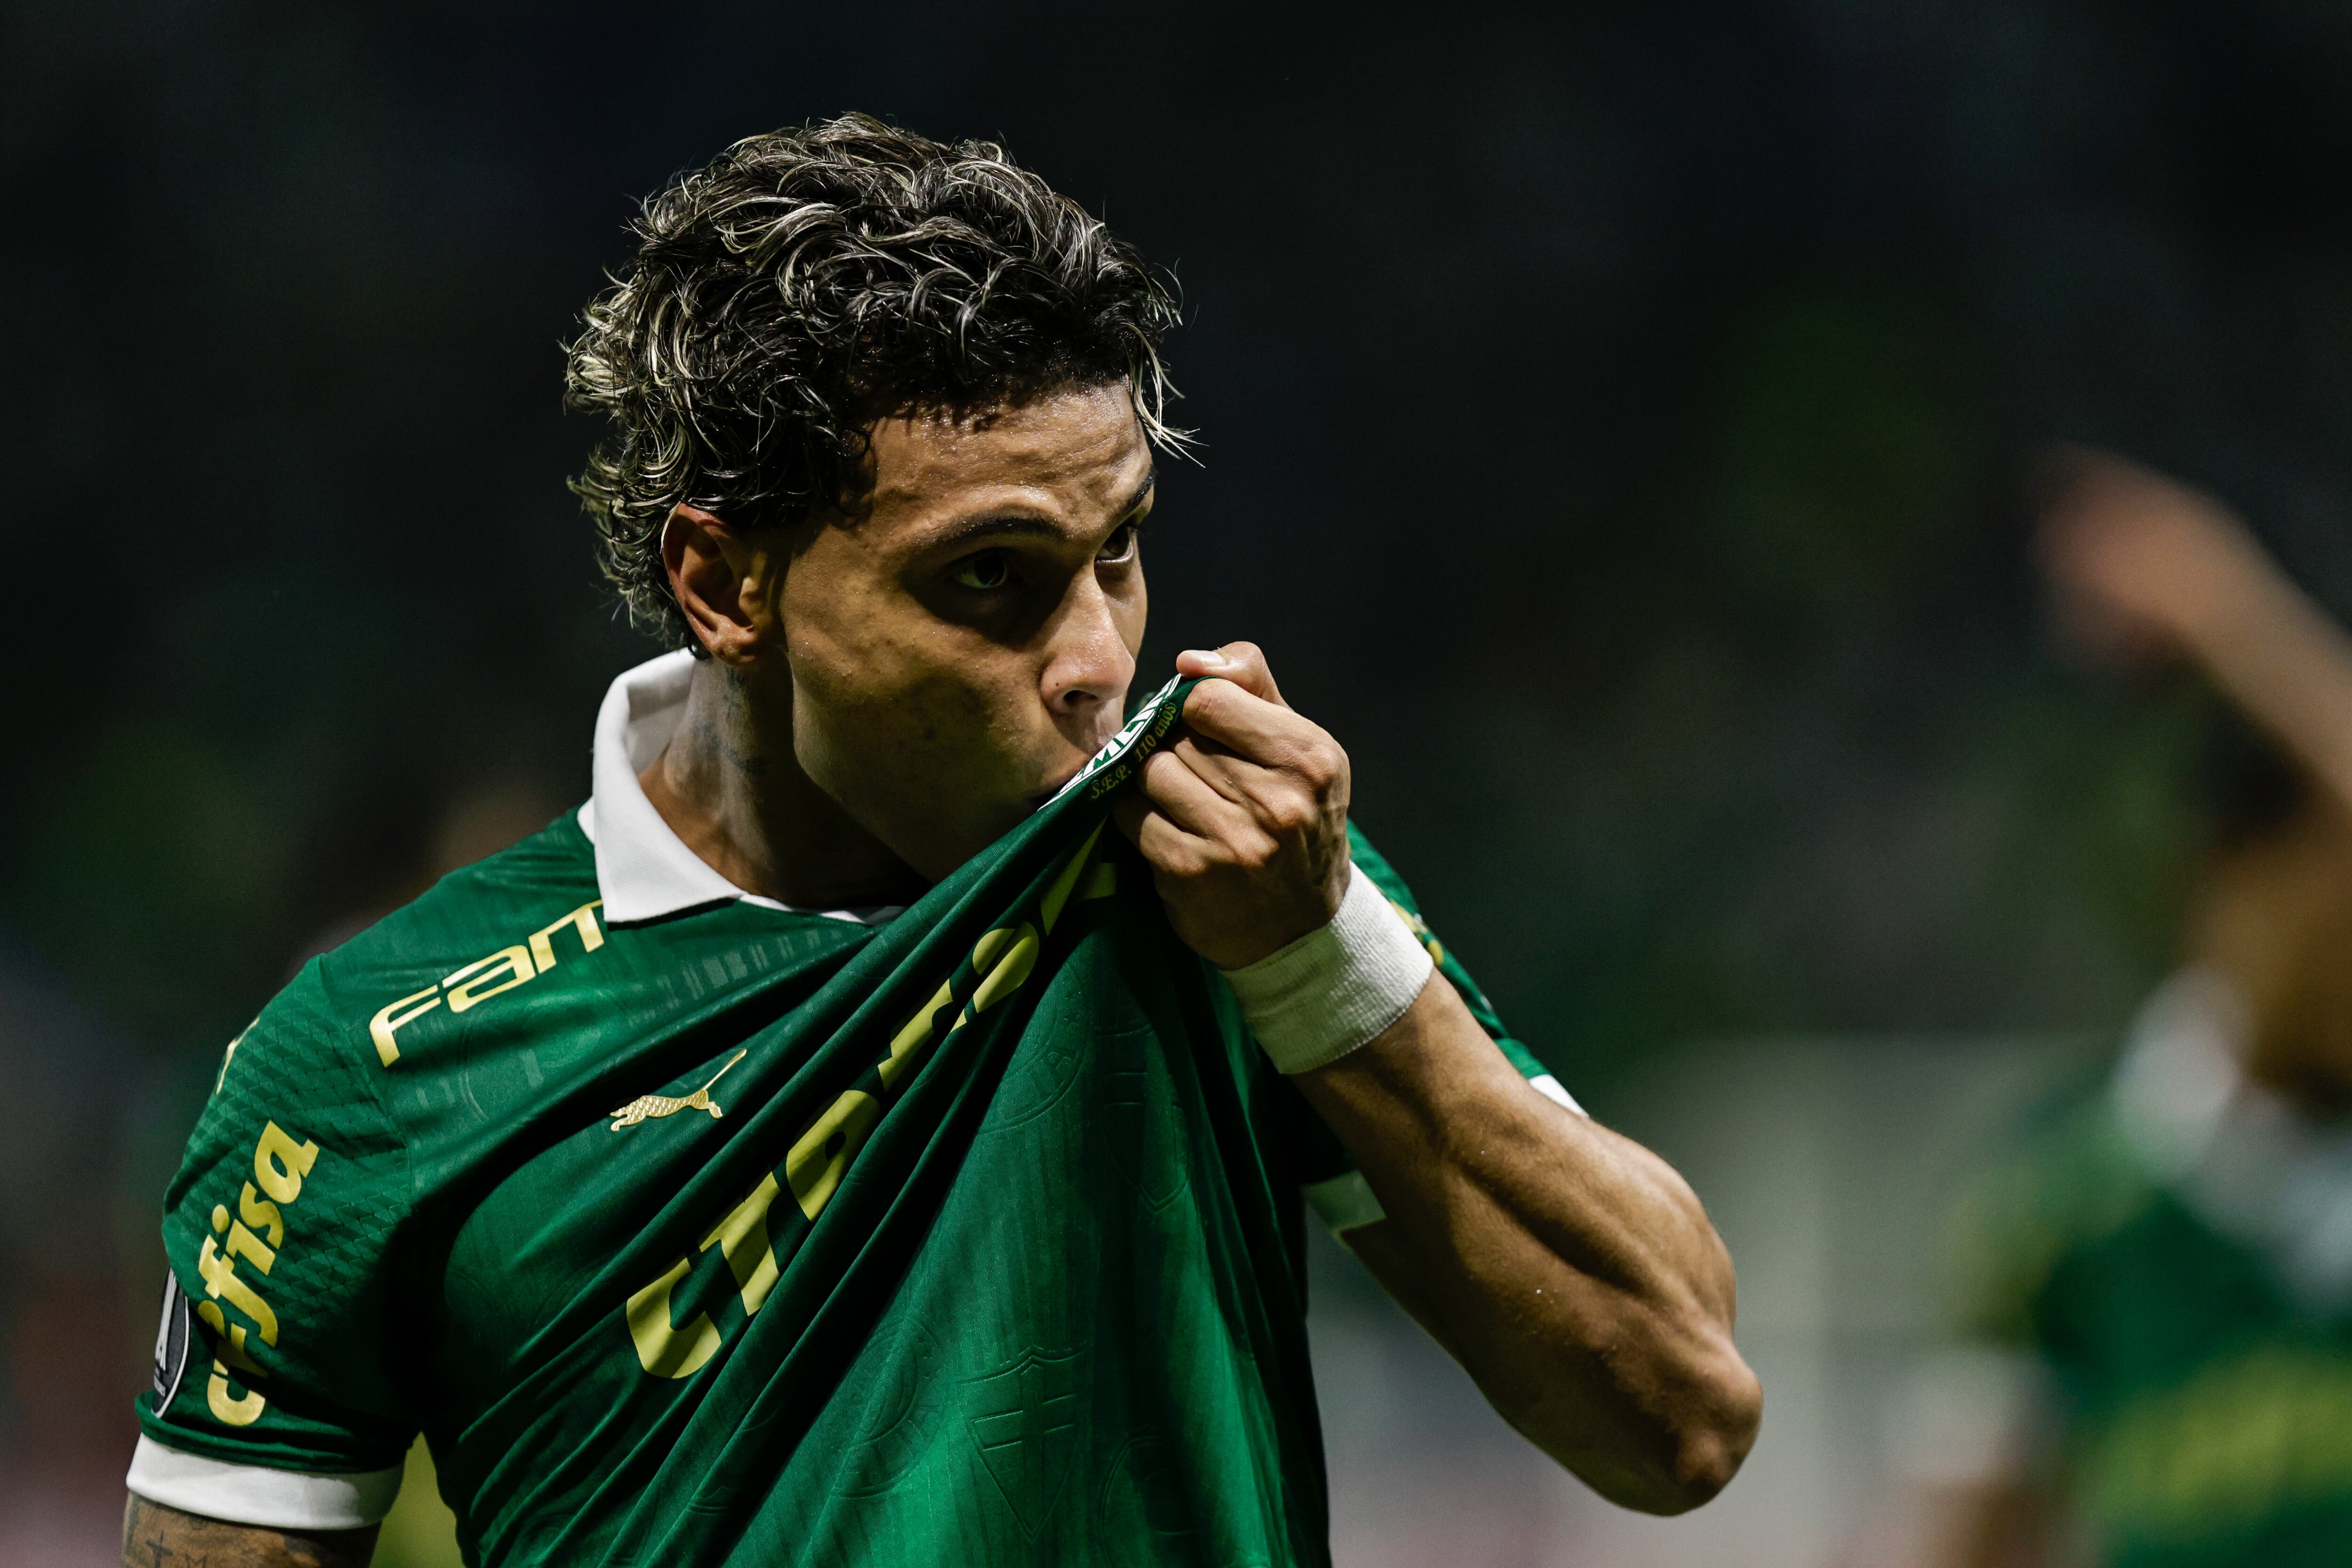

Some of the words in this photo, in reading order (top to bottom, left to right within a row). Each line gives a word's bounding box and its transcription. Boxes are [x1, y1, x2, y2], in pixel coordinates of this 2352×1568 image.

[1091, 764, 1131, 799] S.E.P.
[1135, 734, 1156, 762] 110
[1155, 703, 1176, 738] anos
